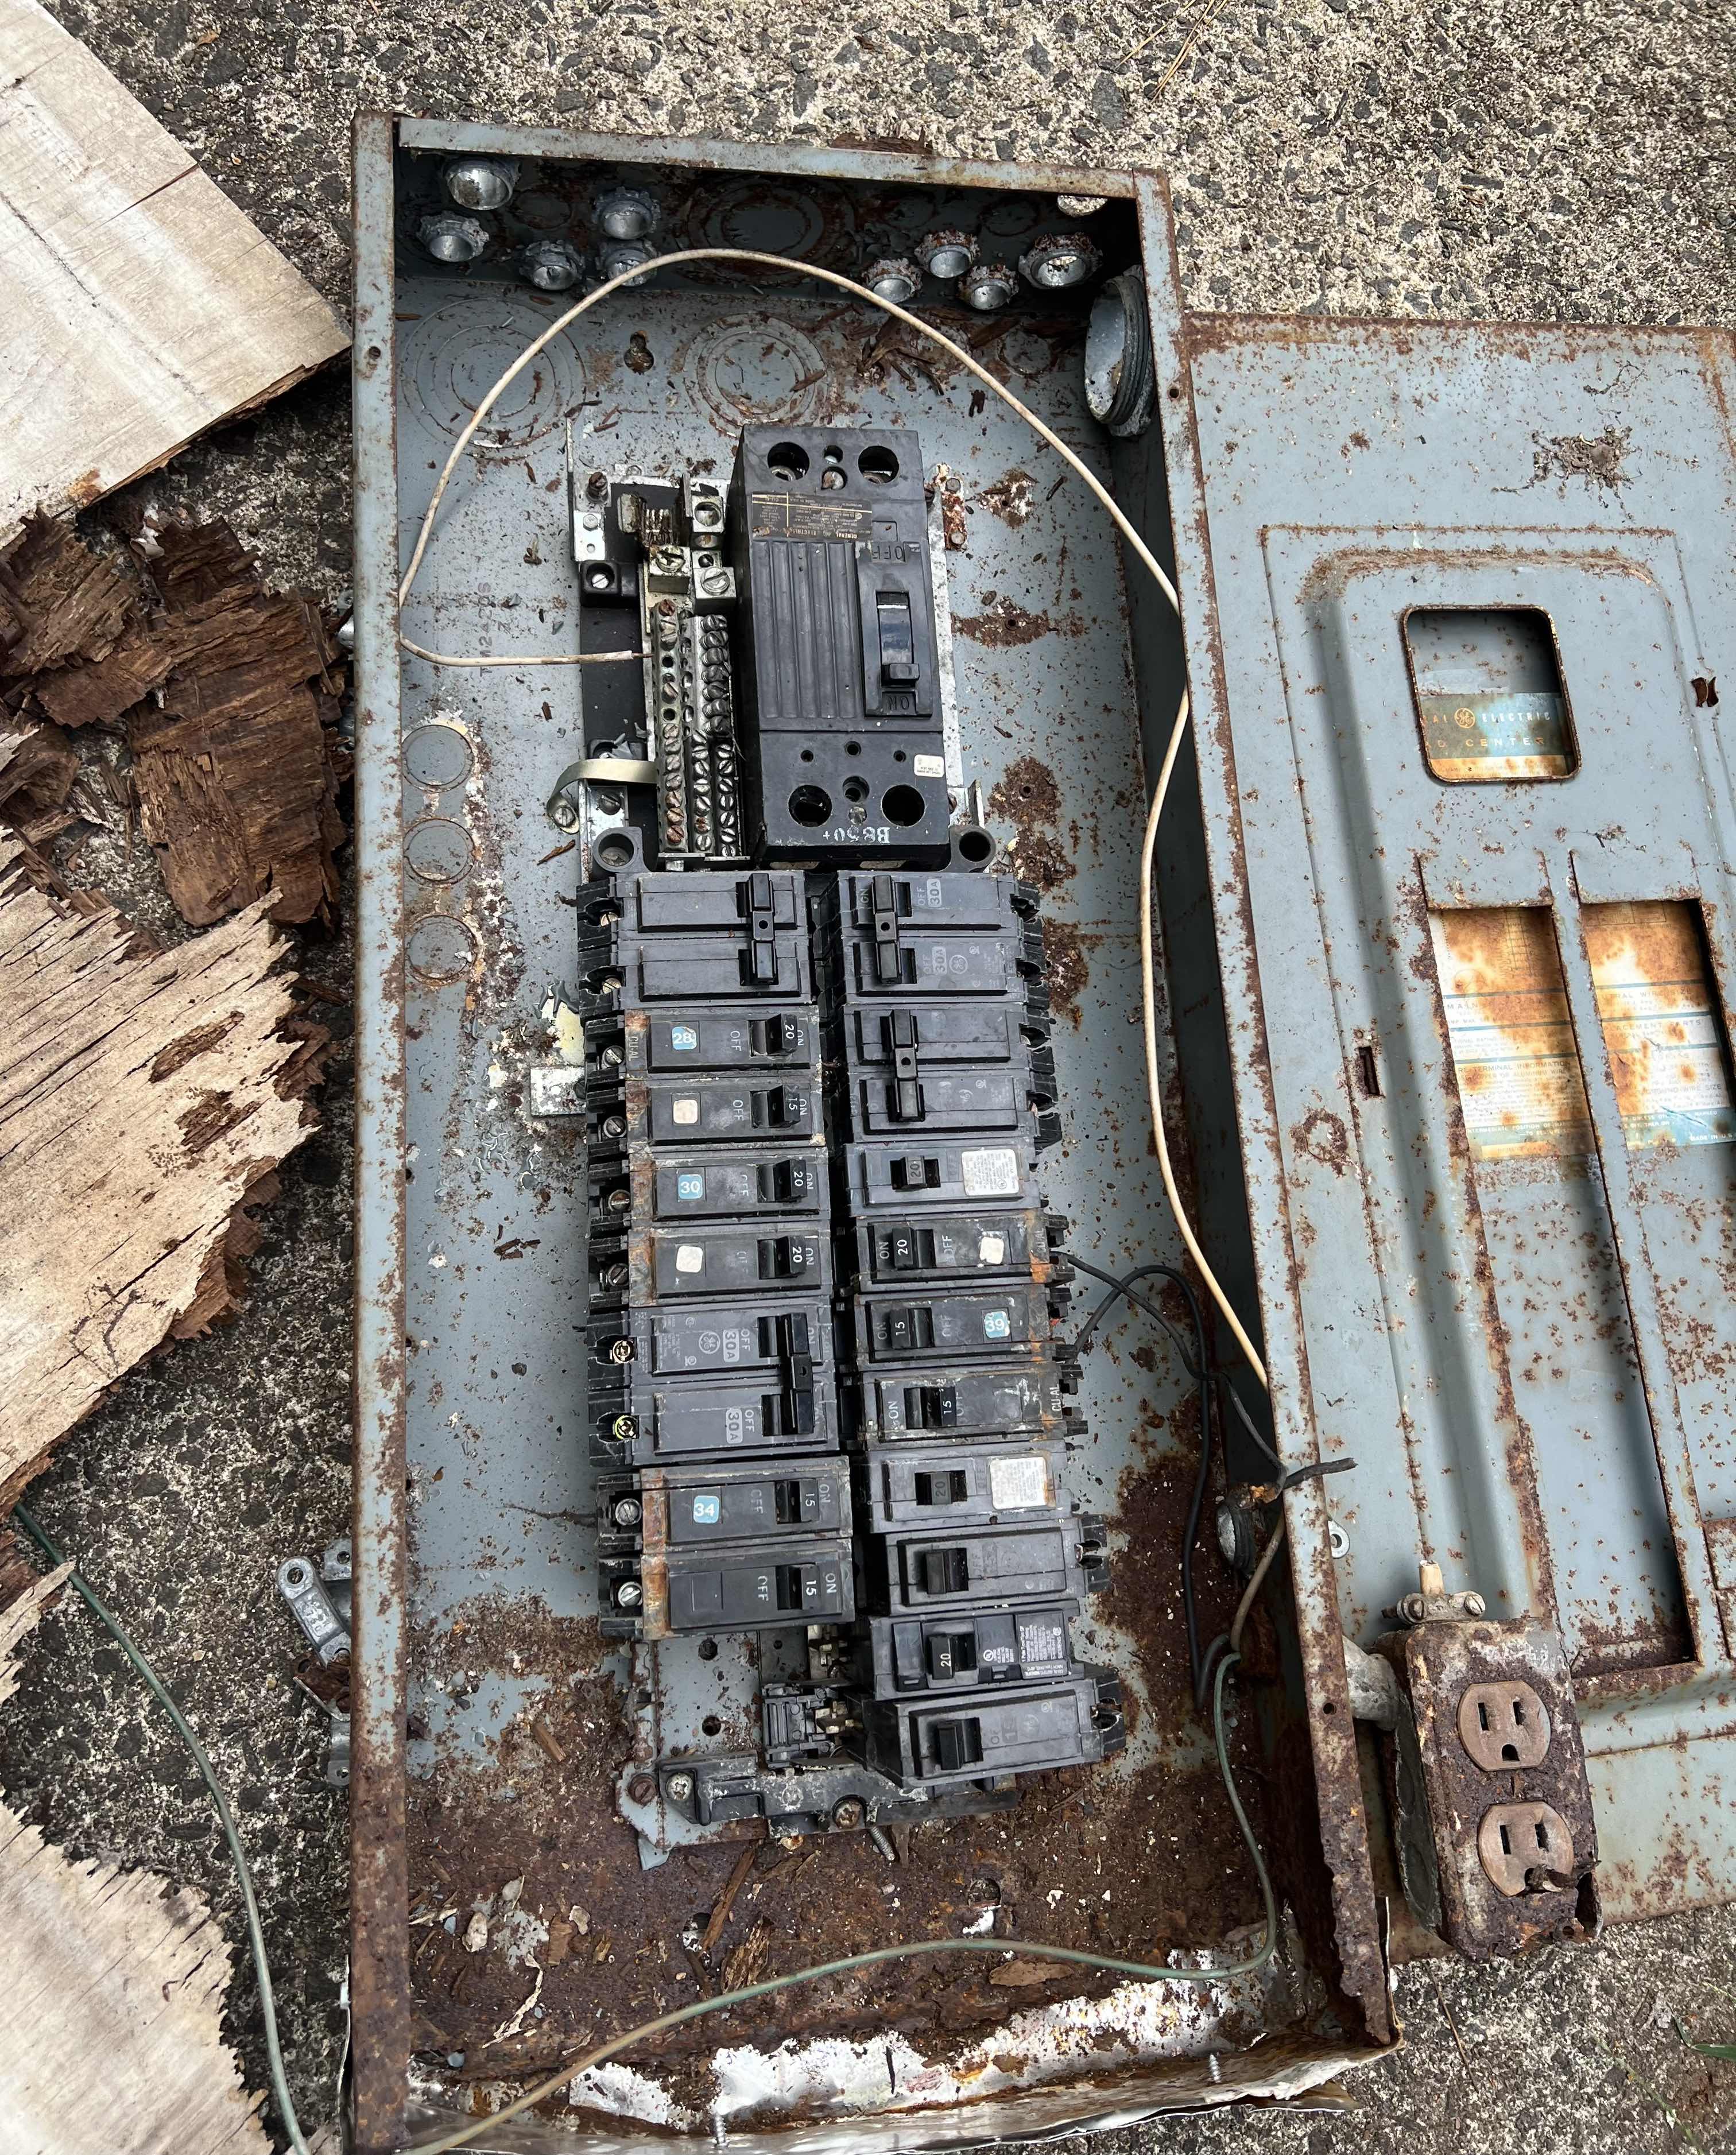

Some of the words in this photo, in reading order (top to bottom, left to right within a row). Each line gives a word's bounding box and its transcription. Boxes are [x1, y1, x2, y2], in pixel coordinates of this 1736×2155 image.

[835, 531, 858, 540] GENERAL
[872, 545, 904, 560] OFF
[887, 695, 910, 711] ON
[1482, 712, 1551, 723] ELECTRIC
[1466, 737, 1544, 747] CENTER
[917, 886, 926, 905] OFF
[929, 881, 940, 904] 30A
[923, 954, 931, 974] OFF
[934, 949, 945, 972] 30A
[785, 1025, 794, 1039] 20
[730, 1030, 742, 1051] OFF
[1517, 1060, 1571, 1069] INFORMATION
[733, 1100, 743, 1121] OFF
[789, 1098, 797, 1110] 15
[800, 1099, 807, 1115] ON
[909, 1163, 921, 1177] 20
[679, 1180, 702, 1193] 30
[793, 1171, 803, 1186] 20
[792, 1246, 803, 1262] 20
[878, 1242, 890, 1259] ON
[897, 1239, 908, 1255] 20
[877, 1322, 888, 1340] ON
[895, 1321, 905, 1336] 15
[941, 1315, 952, 1336] OFF
[984, 1319, 1005, 1334] 39
[724, 1331, 737, 1359] 30A
[741, 1329, 751, 1351] OFF
[888, 1401, 899, 1419] ON
[943, 1400, 952, 1414] 15
[728, 1412, 740, 1441] 30A
[745, 1410, 754, 1432] OFF
[819, 1484, 830, 1502] ON
[935, 1482, 946, 1497] 20
[805, 1493, 816, 1506] 15
[693, 1502, 716, 1517] 34
[757, 1576, 768, 1601] OFF
[805, 1580, 816, 1596] 15
[826, 1573, 836, 1593] ON
[940, 1653, 951, 1667] 20
